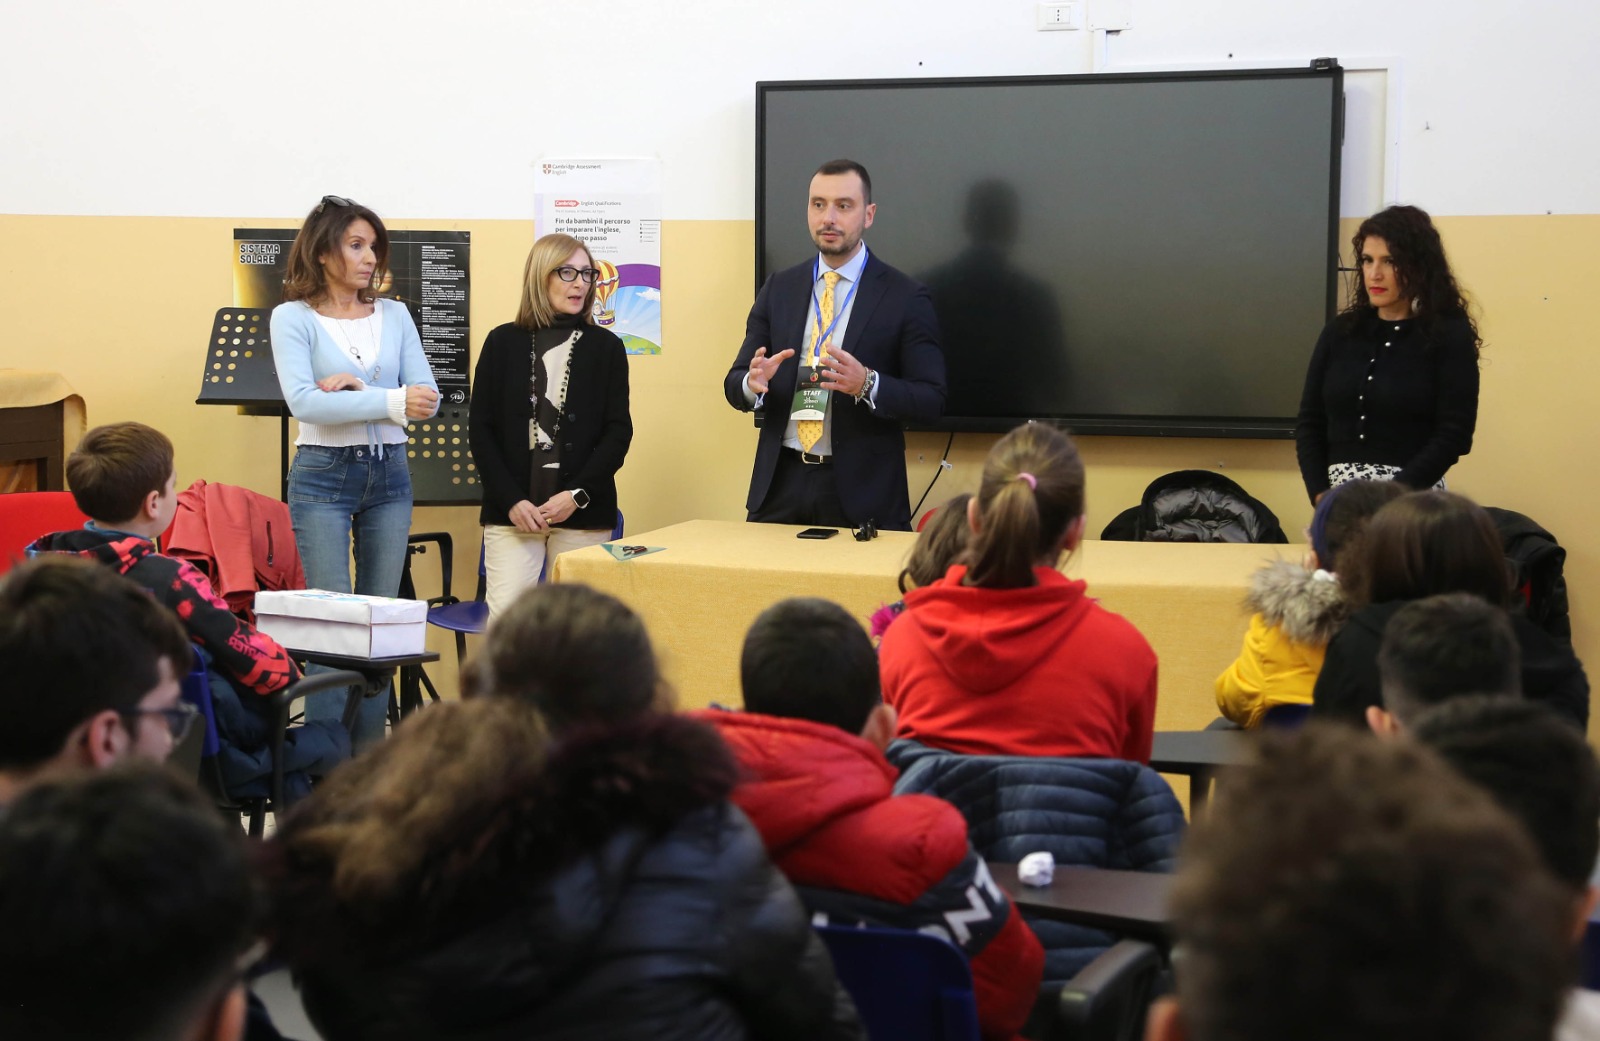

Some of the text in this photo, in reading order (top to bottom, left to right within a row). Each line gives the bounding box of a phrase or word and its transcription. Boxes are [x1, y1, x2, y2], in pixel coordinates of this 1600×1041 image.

[574, 217, 598, 225] bambini
[567, 226, 593, 234] imparare
[594, 226, 621, 235] l'inglese,
[240, 244, 280, 254] SISTEMA
[240, 254, 275, 264] SOLARE
